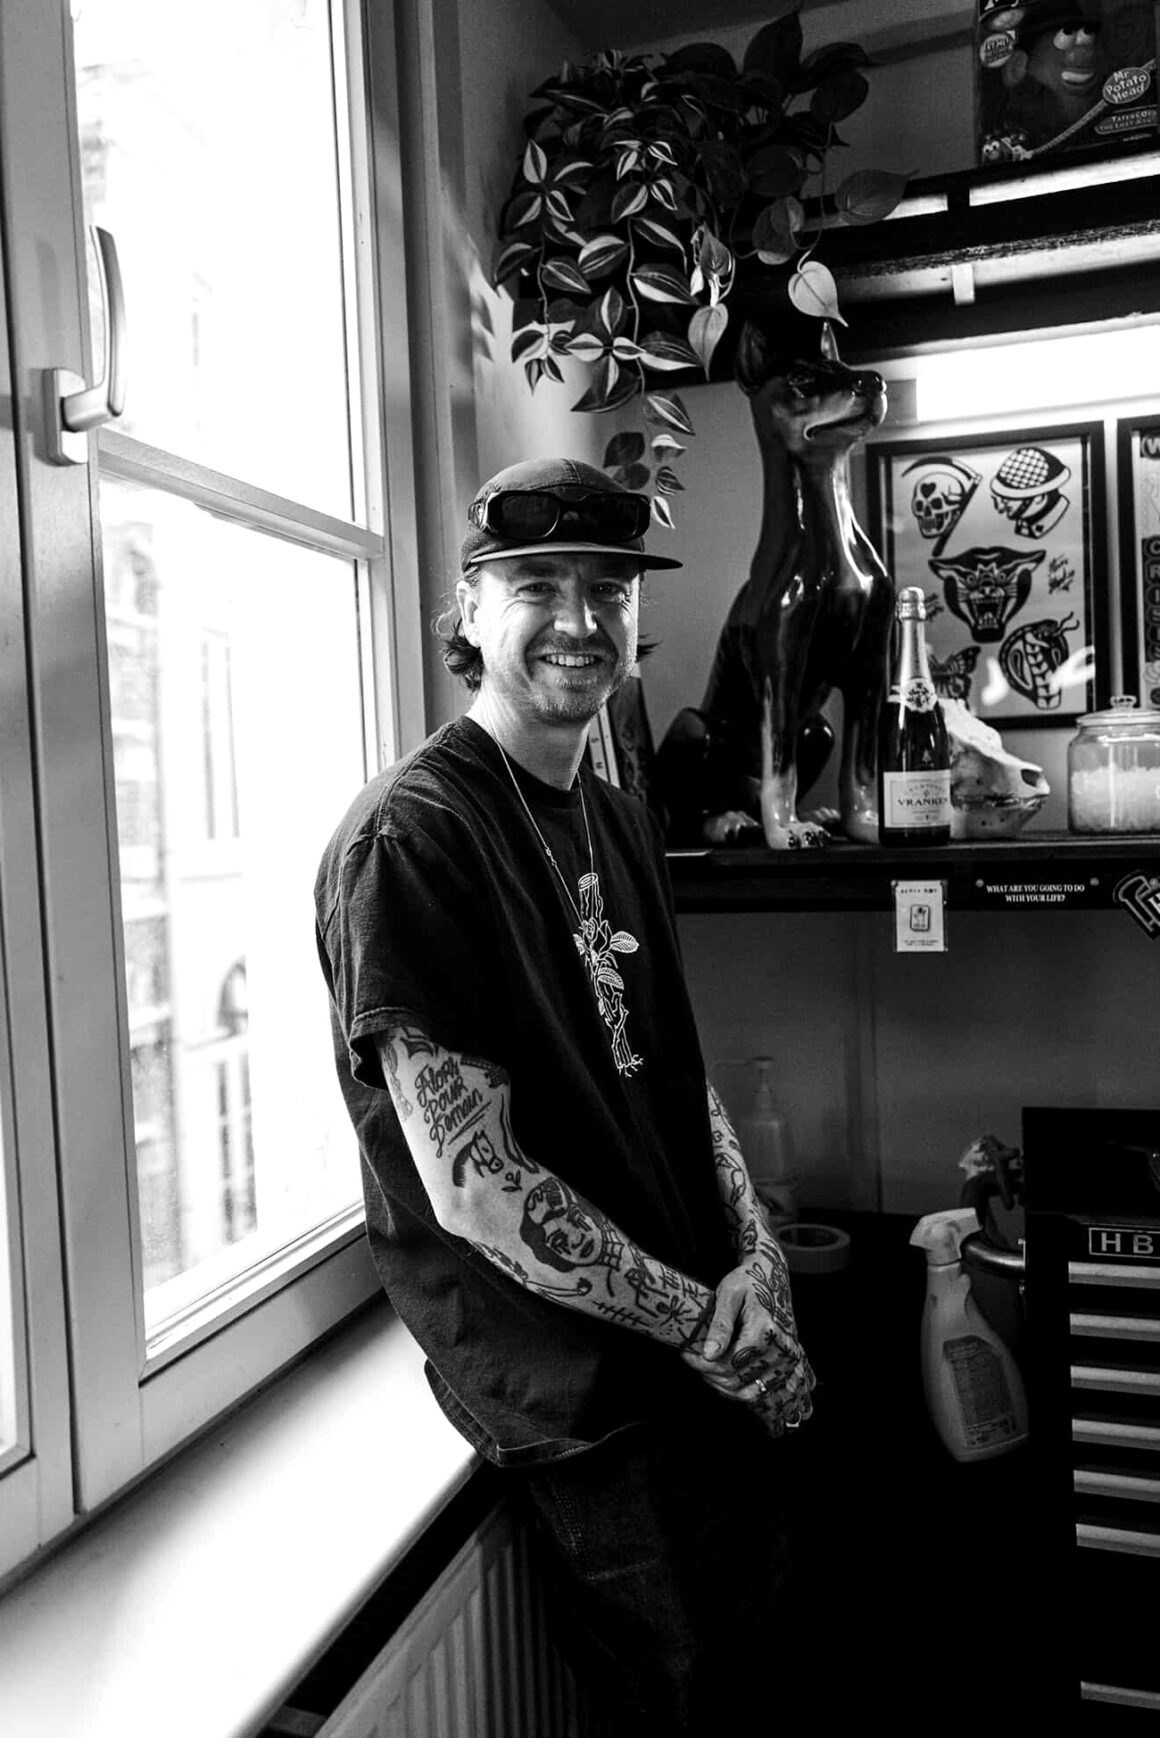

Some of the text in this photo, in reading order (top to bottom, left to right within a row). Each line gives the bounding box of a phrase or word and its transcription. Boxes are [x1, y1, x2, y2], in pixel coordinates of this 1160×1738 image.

[1113, 71, 1129, 83] Mr
[1105, 74, 1147, 96] Potato
[1112, 82, 1144, 102] Head
[986, 884, 1085, 893] WHAT ARE YOU GOING TO DO
[1005, 893, 1066, 902] WITH YOUR LIFE?
